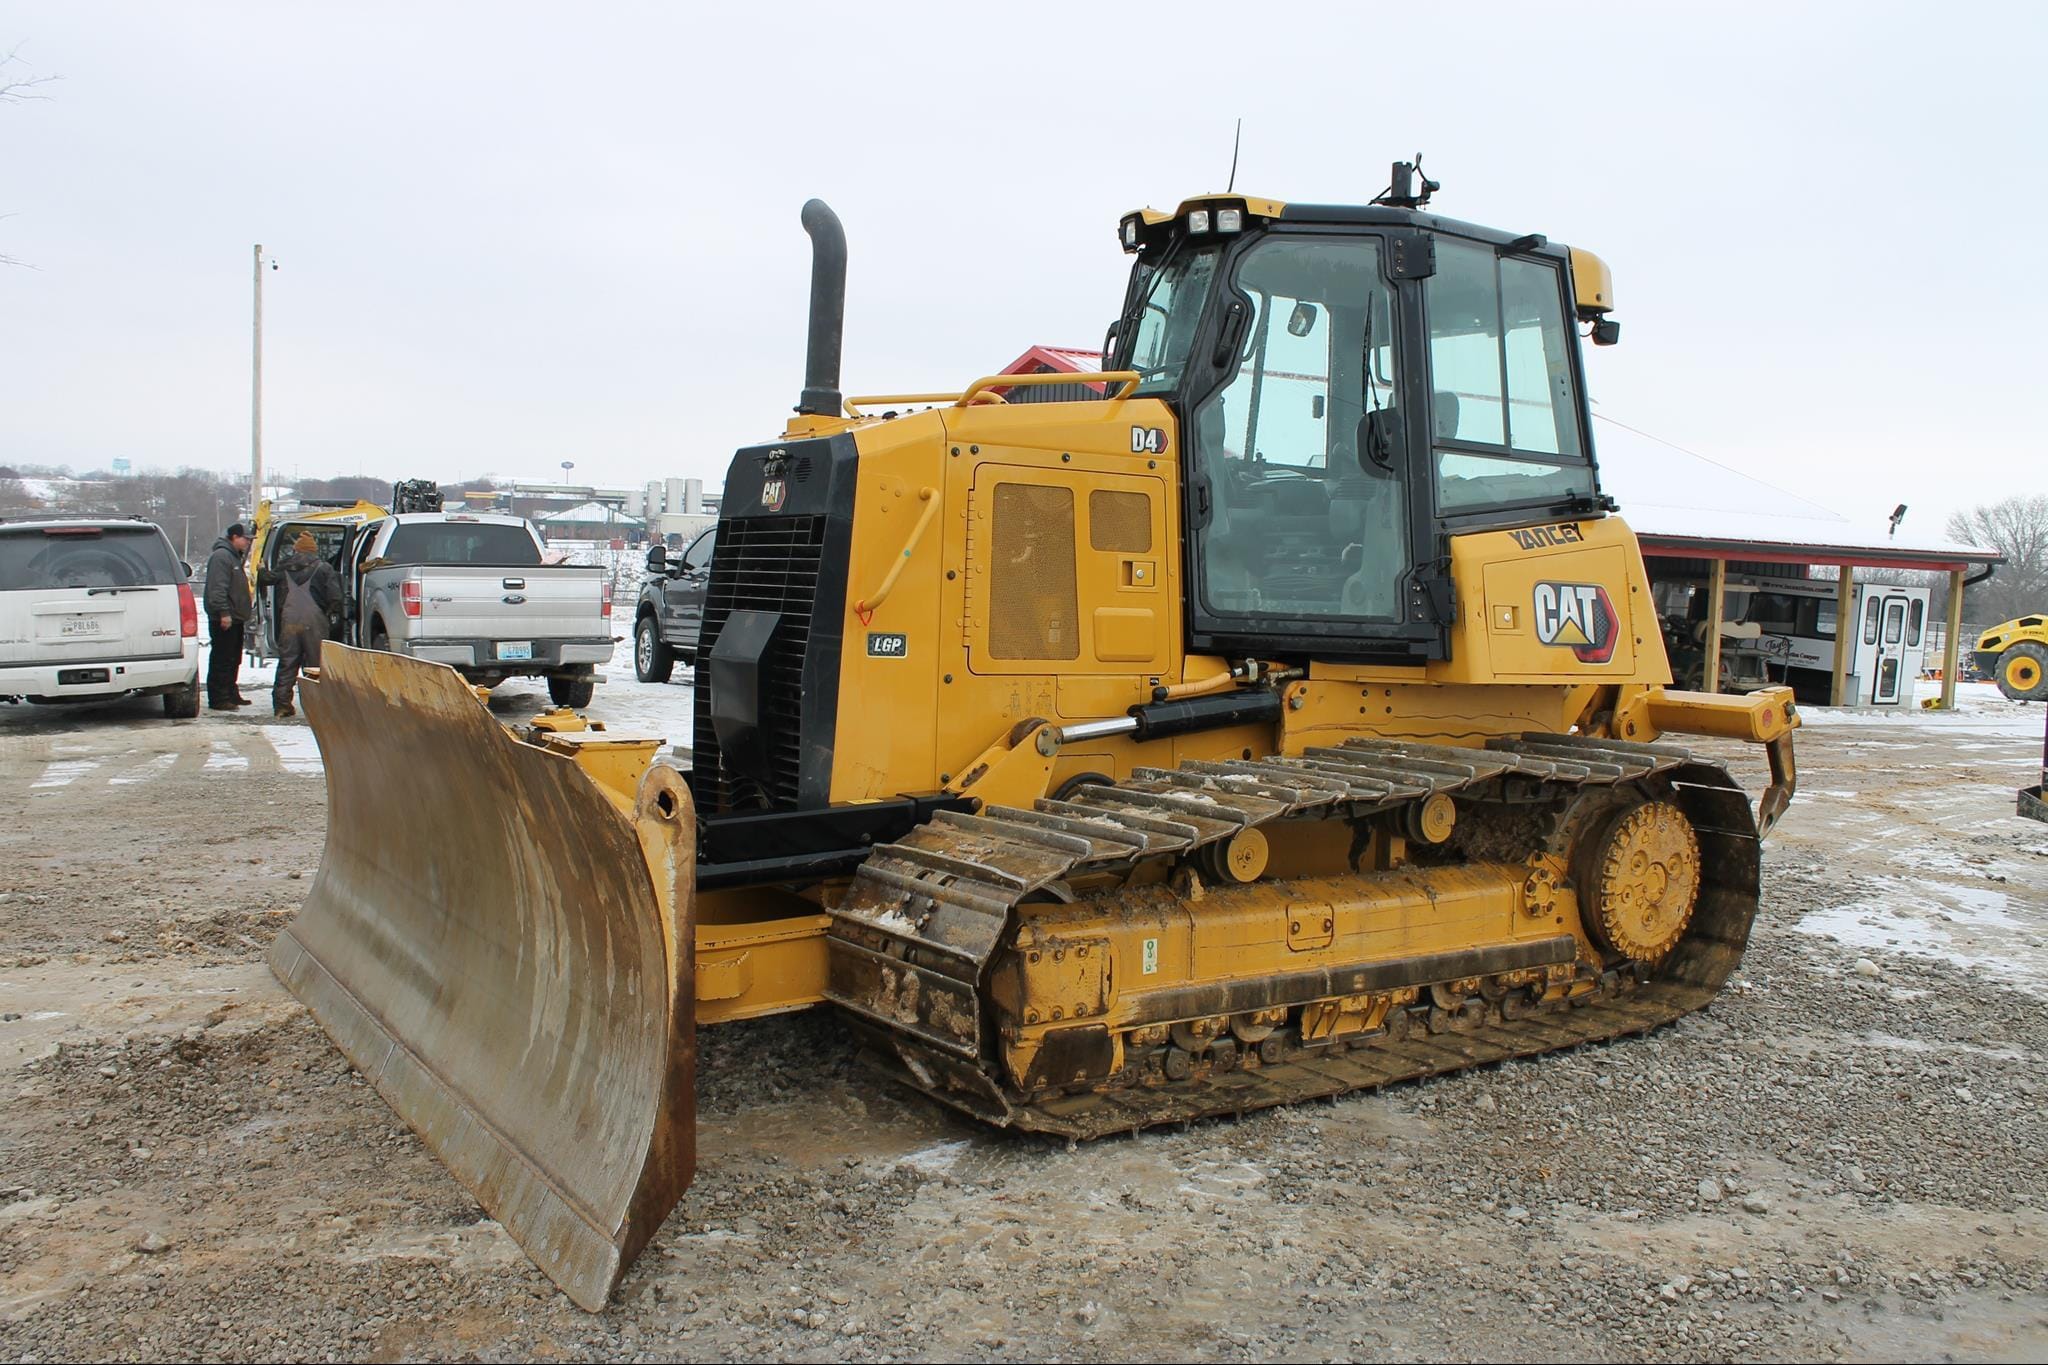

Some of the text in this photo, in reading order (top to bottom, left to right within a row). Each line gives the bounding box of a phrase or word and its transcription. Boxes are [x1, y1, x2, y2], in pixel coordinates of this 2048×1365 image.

[1132, 427, 1157, 452] D4
[762, 482, 781, 504] CAT
[1508, 523, 1584, 550] YANCEY
[1535, 583, 1597, 644] CAT
[874, 638, 902, 652] LGP
